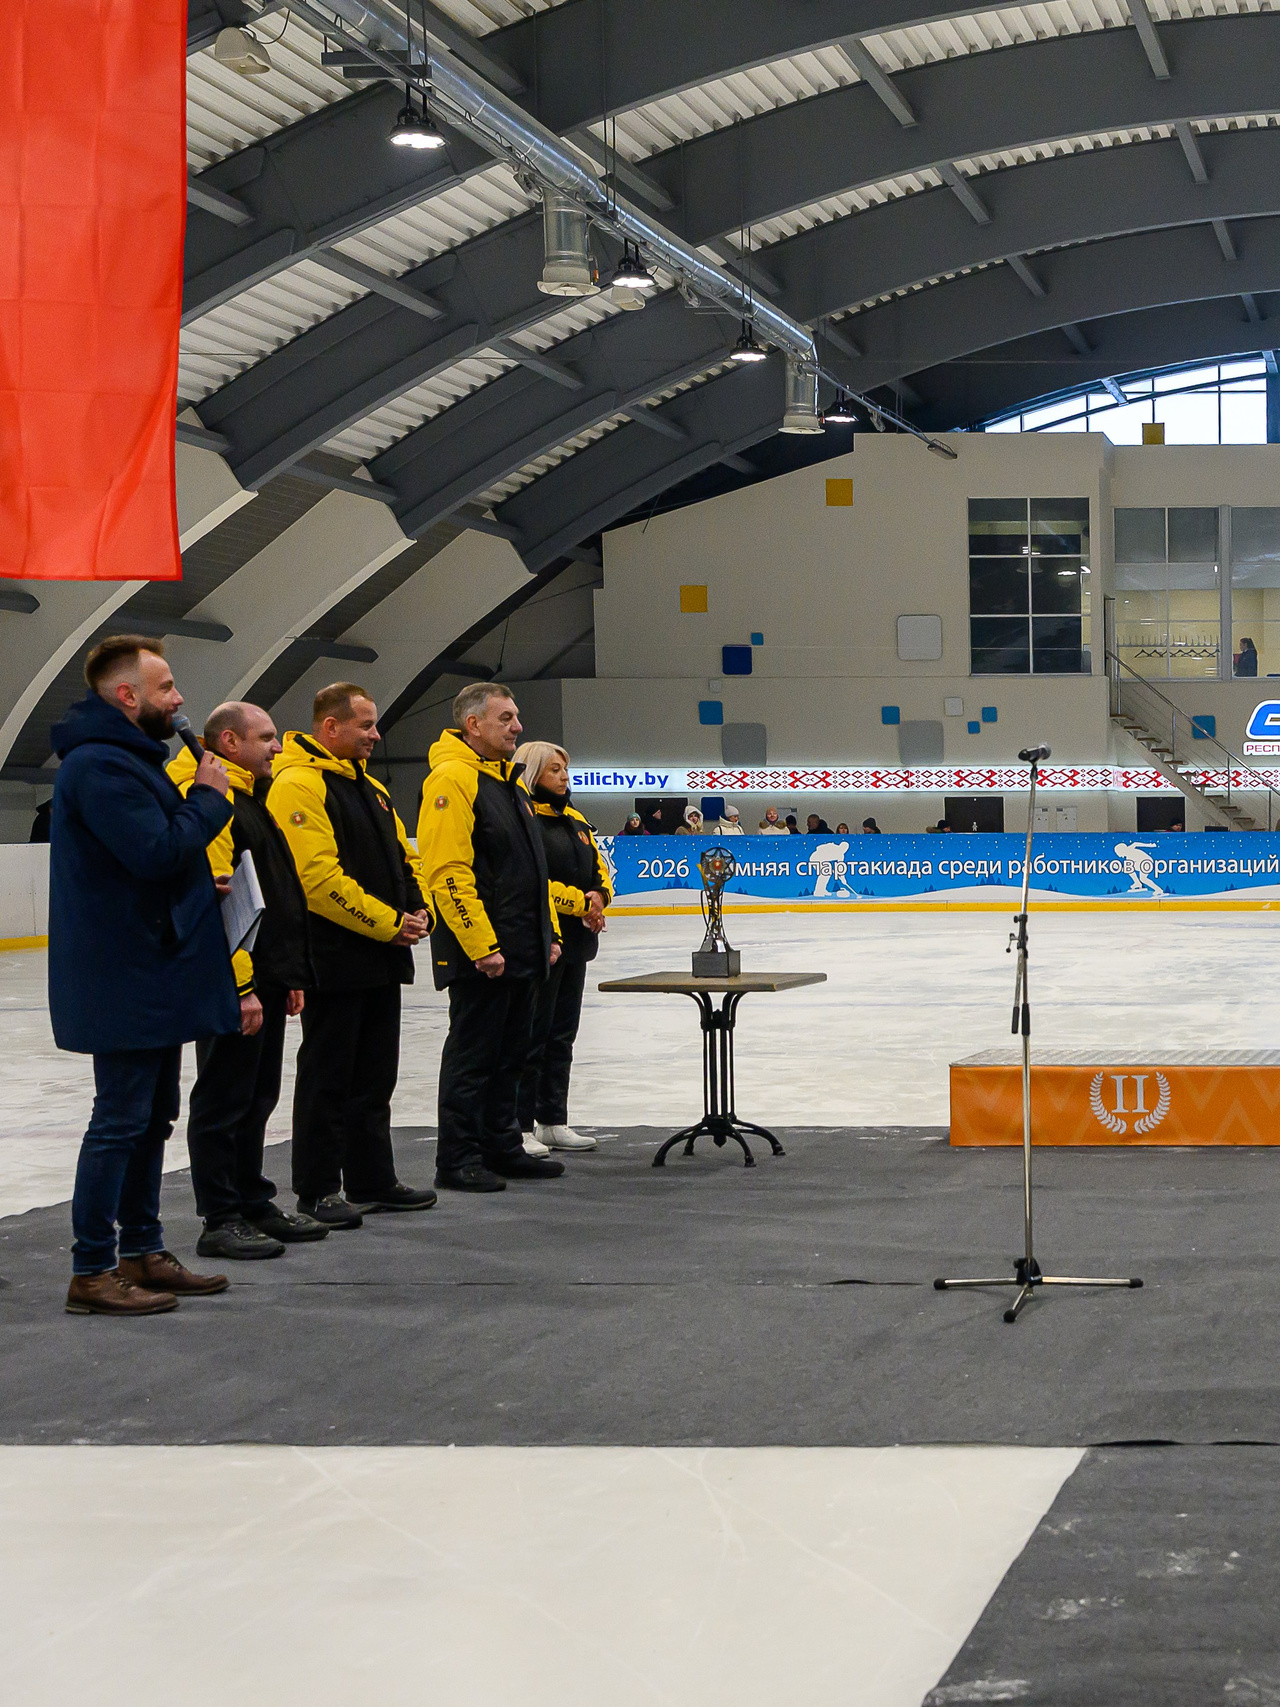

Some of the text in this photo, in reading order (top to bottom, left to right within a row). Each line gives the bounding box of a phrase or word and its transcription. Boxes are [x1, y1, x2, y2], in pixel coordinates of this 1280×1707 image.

[572, 771, 669, 788] silichy.by
[637, 858, 691, 879] 2026
[795, 859, 933, 879] спартакиада
[938, 858, 1003, 879] среди
[1008, 853, 1136, 879] работников
[1139, 853, 1280, 879] организаций
[329, 890, 378, 928] BELARUS
[446, 877, 473, 929] BELARUS
[1110, 1074, 1150, 1113] II
